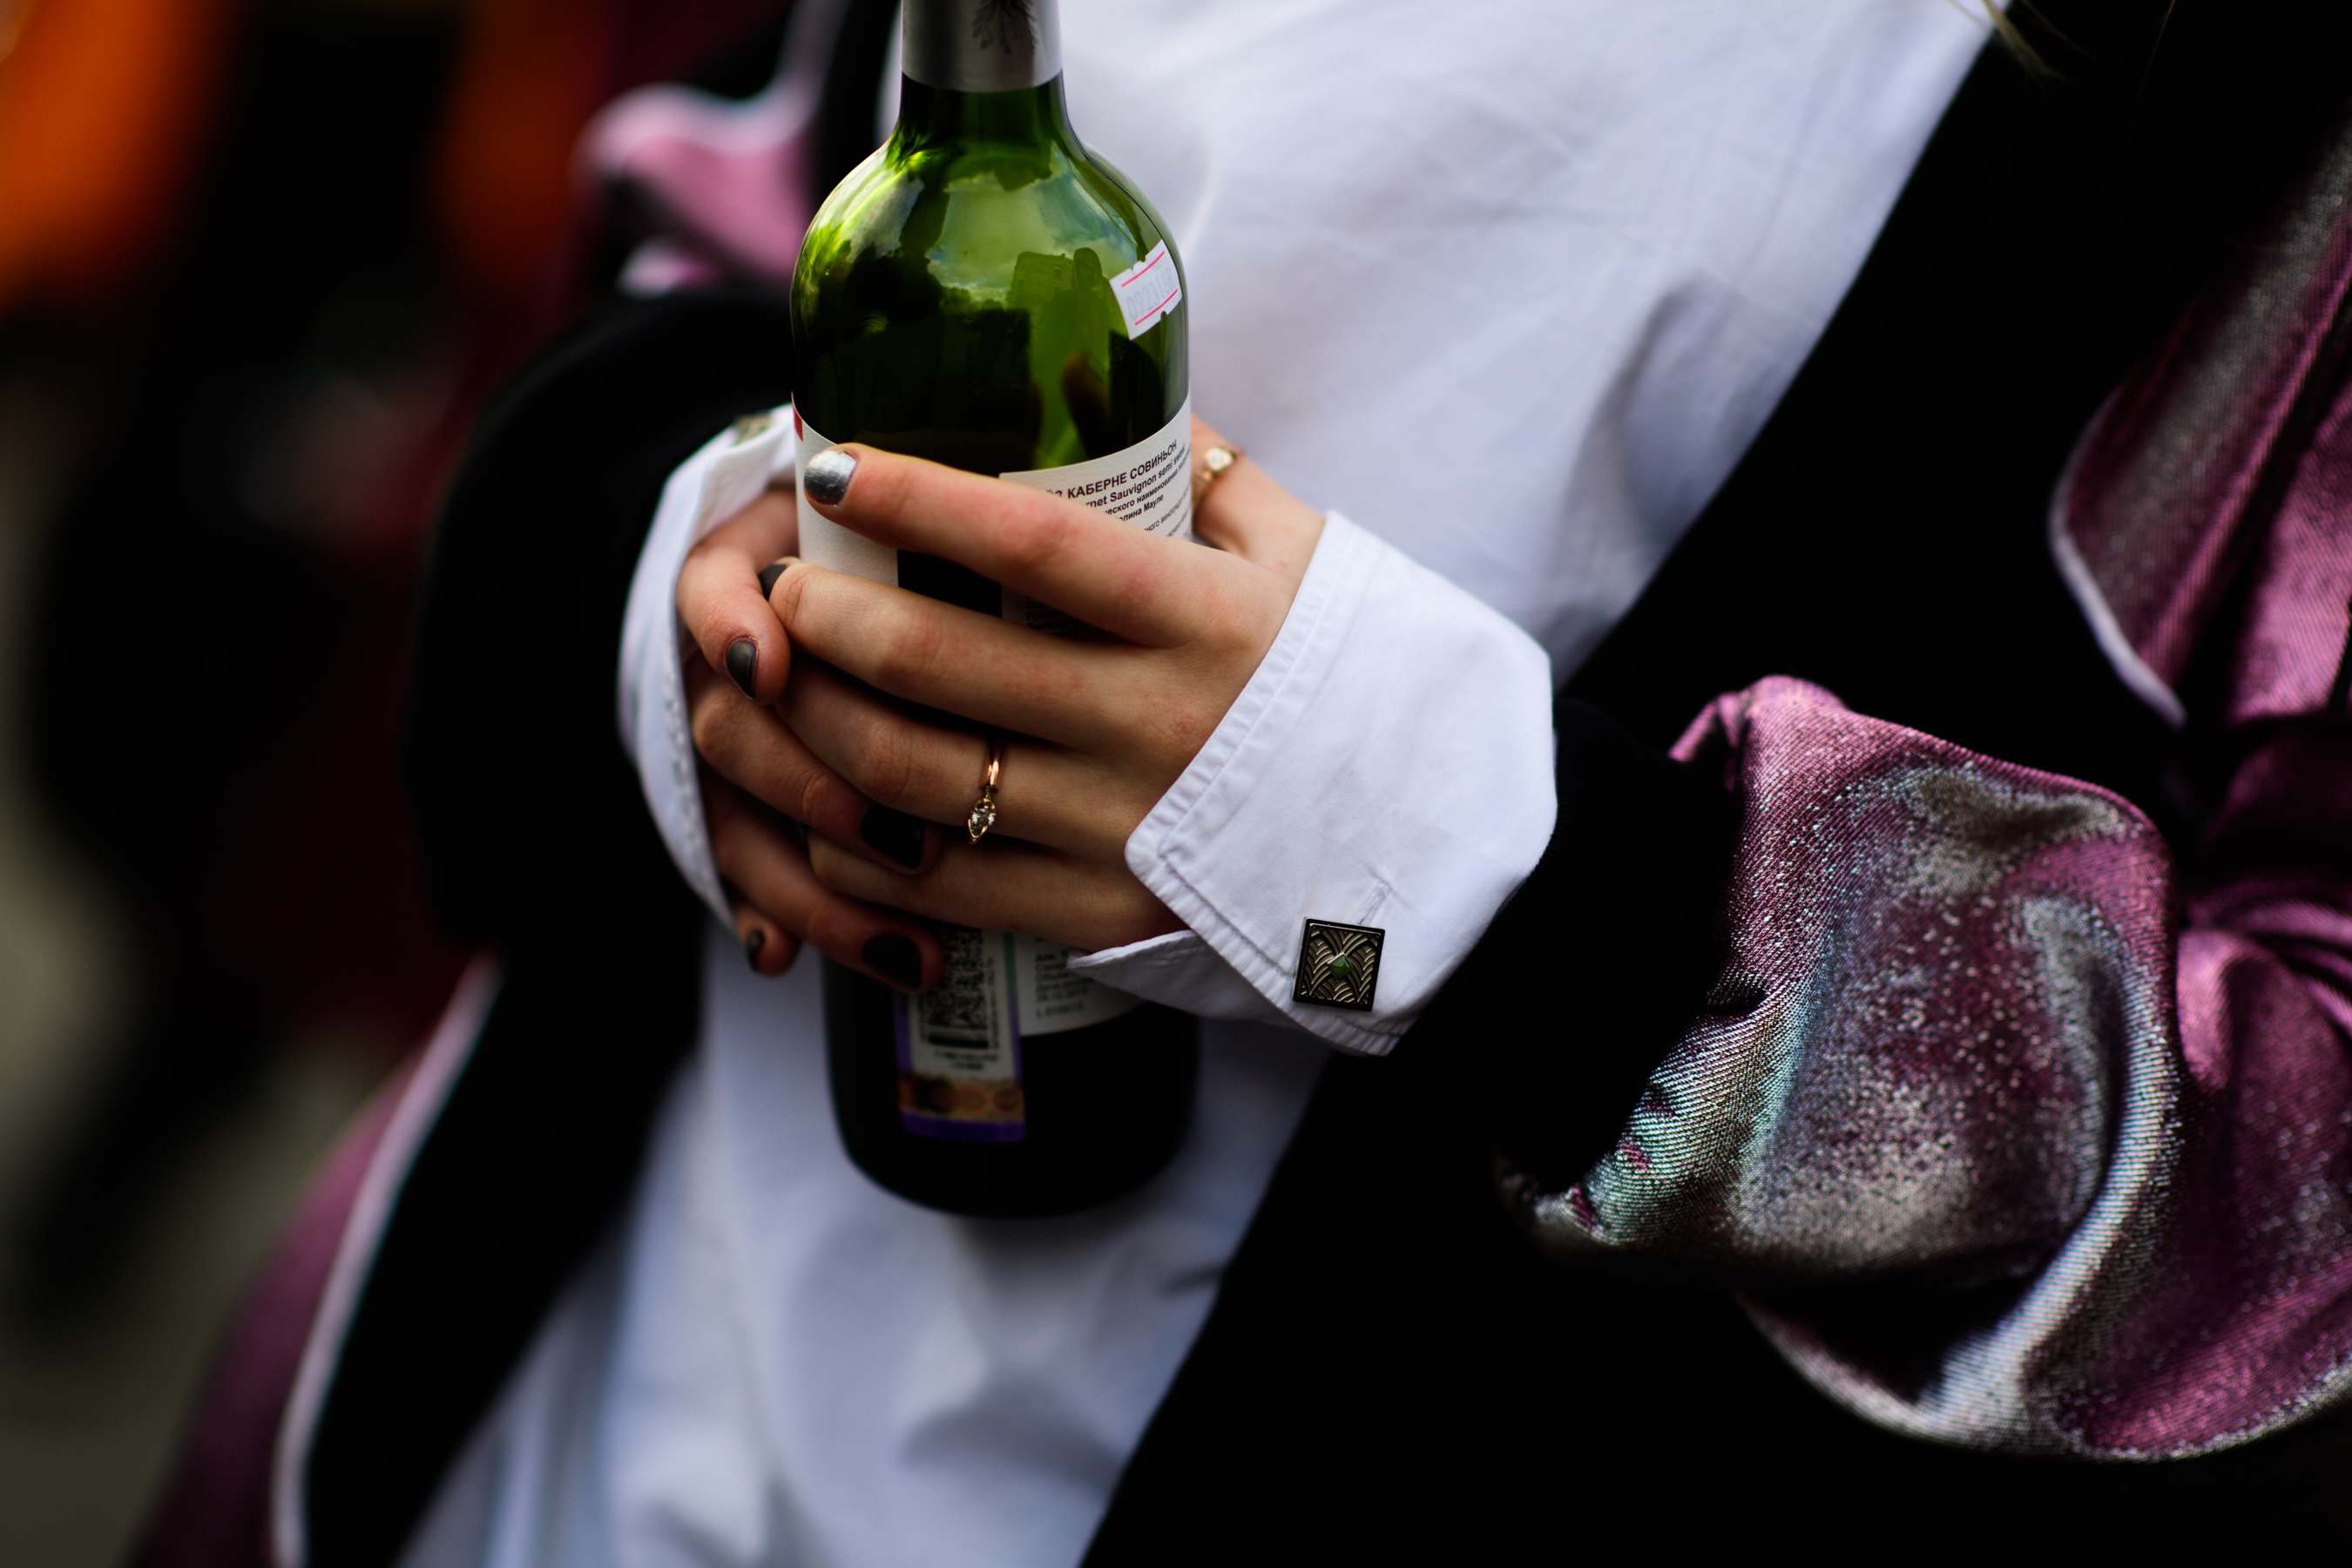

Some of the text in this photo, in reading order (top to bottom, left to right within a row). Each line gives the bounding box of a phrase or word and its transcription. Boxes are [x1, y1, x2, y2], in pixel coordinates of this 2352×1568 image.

[1067, 472, 1127, 499] КАБЕРНЕ
[1130, 439, 1177, 479] СОВИНЬОН
[1110, 474, 1157, 503] Sauvignon
[1158, 458, 1173, 478] semi
[1143, 494, 1164, 512] Мауле
